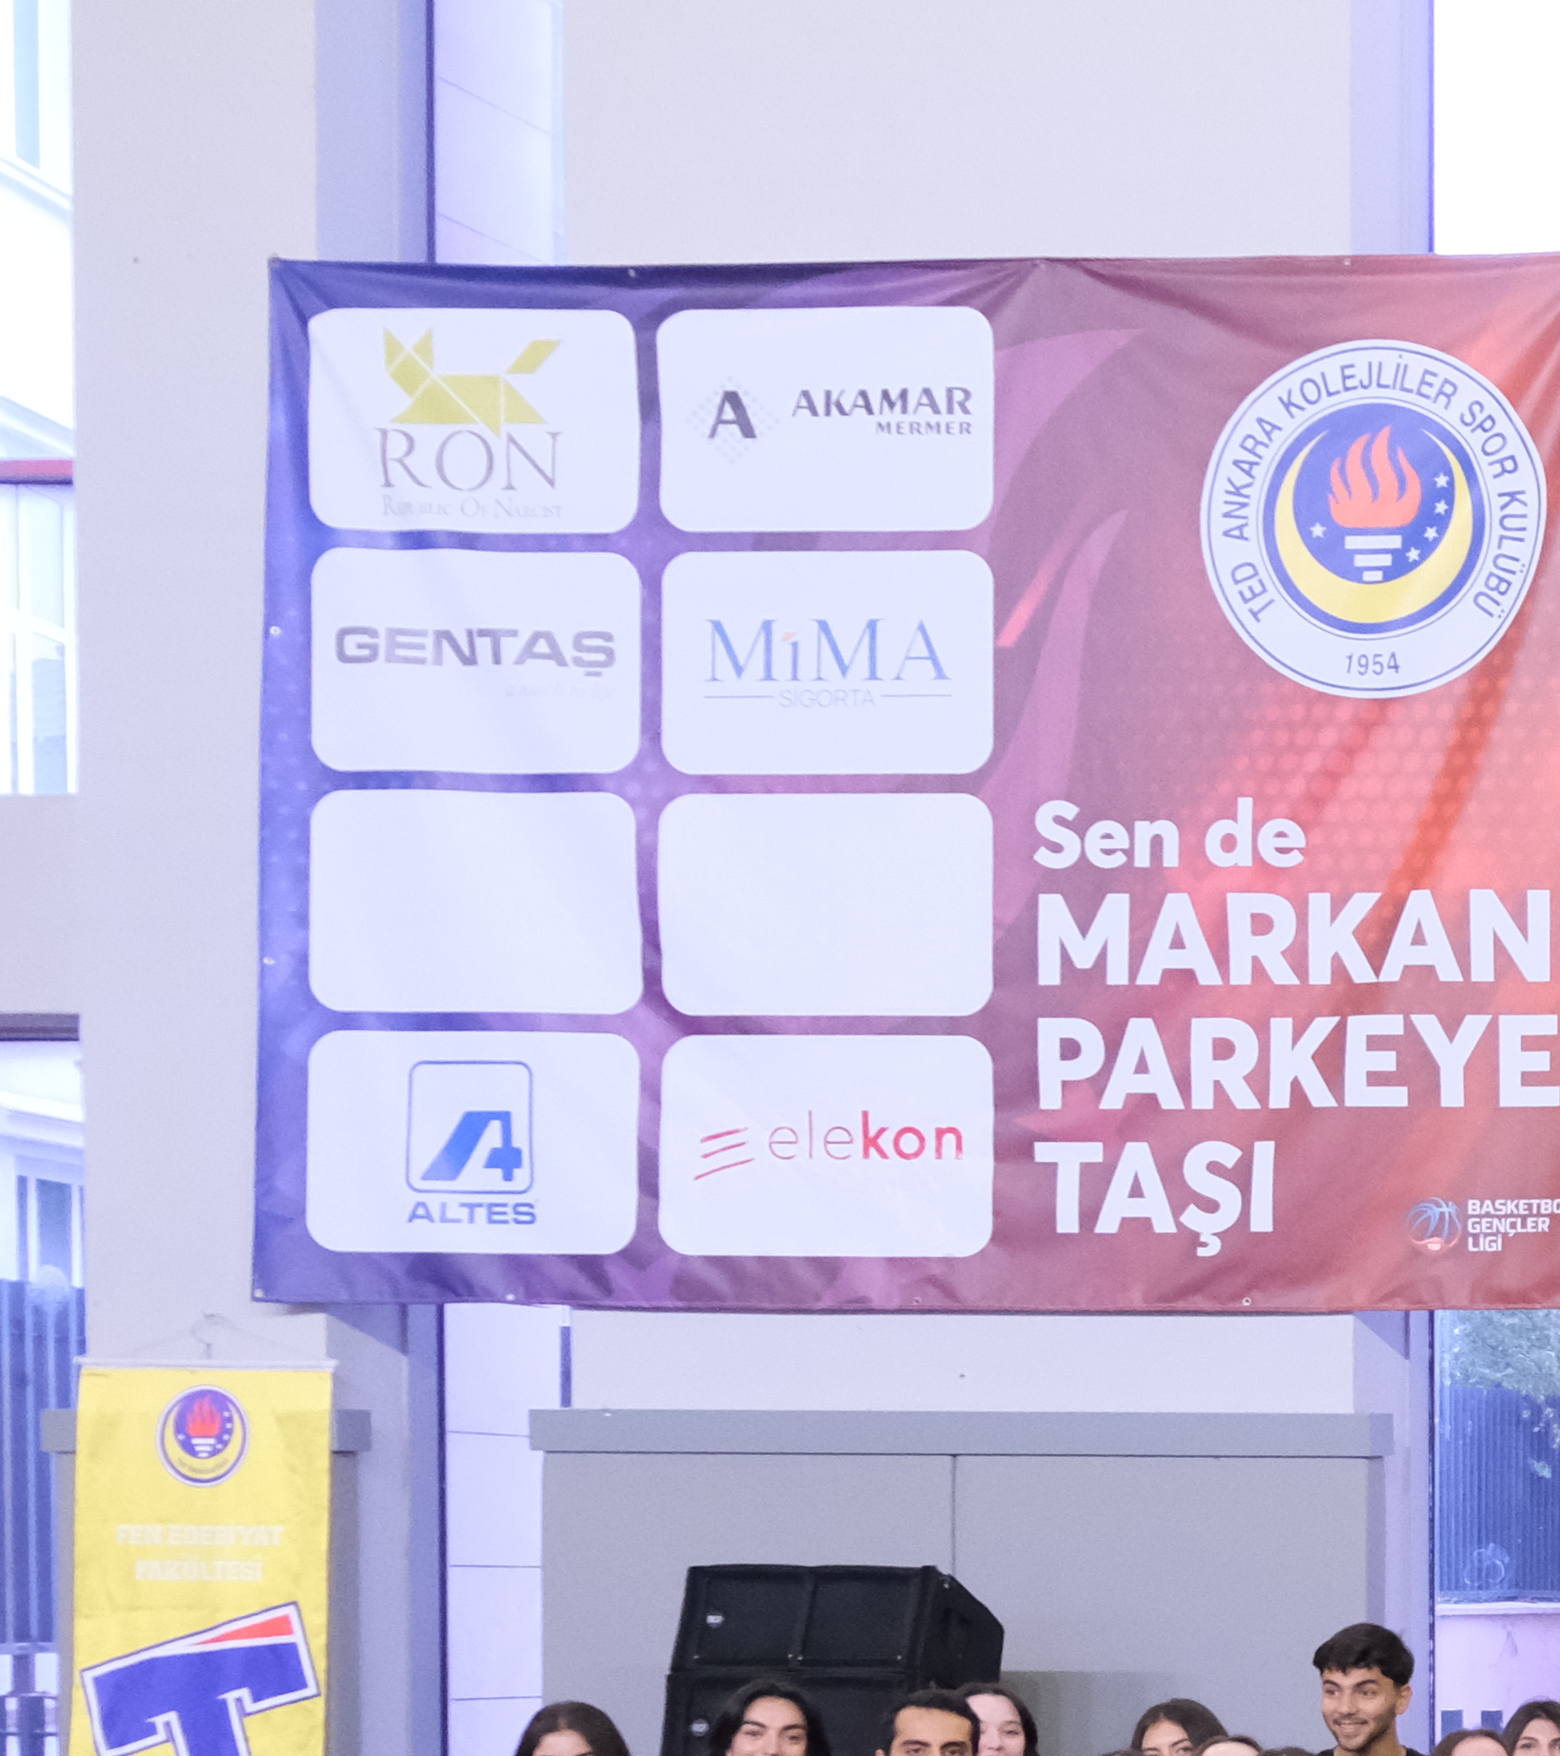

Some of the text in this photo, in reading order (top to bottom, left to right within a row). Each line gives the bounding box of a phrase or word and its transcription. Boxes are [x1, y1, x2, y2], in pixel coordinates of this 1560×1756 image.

[792, 386, 972, 417] AKAMAR
[876, 421, 972, 435] MERMER
[375, 427, 563, 491] RON
[1221, 354, 1528, 623] TED ANKARA KOLEJLİLER SPOR KULÜBÜ
[335, 625, 616, 677] GENTAŞ
[1345, 652, 1401, 676] 1954
[1033, 797, 1307, 869] Sen de
[1037, 1014, 1560, 1110] PARKEYE
[767, 1110, 964, 1160] elekon
[406, 1200, 538, 1225] ALTES
[1034, 1141, 1276, 1256] TAŞI
[1467, 1217, 1550, 1237] GENÇLER
[1468, 1234, 1502, 1252] LİGİ
